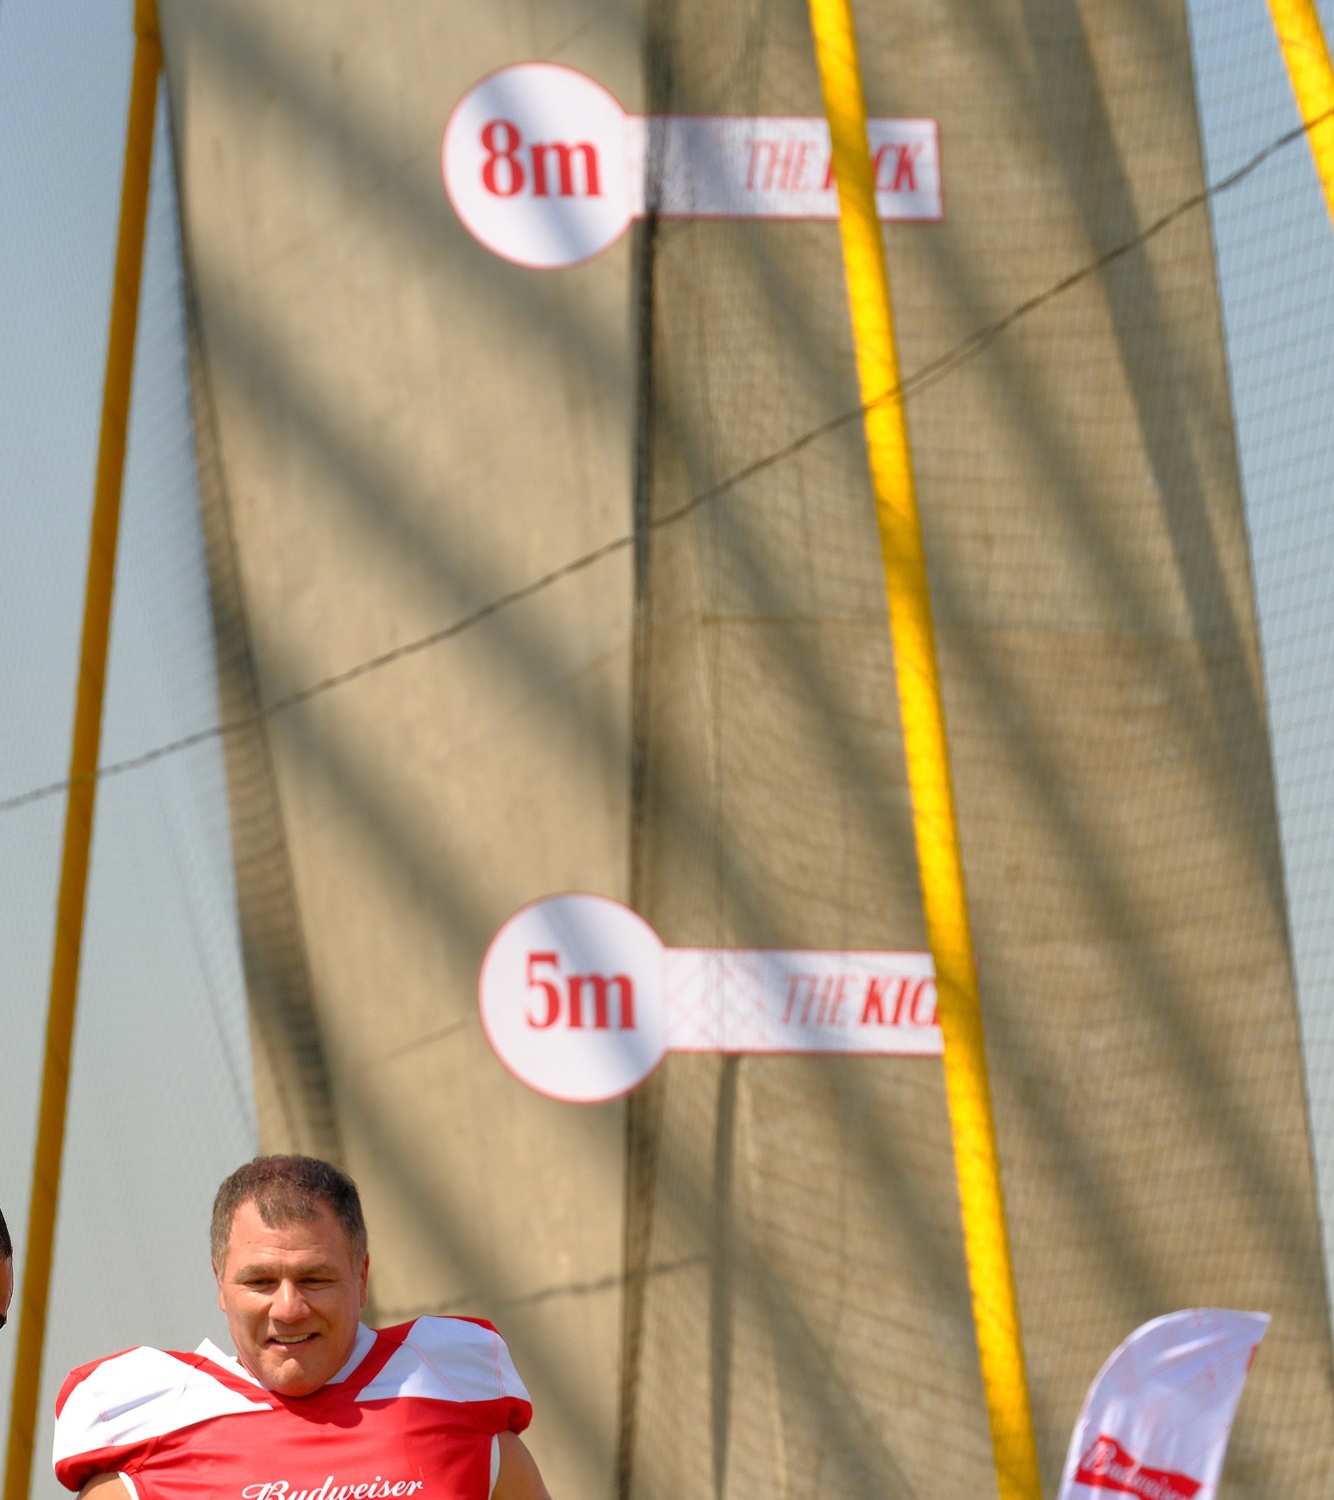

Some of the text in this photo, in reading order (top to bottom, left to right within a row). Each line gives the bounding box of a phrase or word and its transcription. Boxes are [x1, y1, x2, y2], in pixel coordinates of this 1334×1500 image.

[480, 118, 923, 199] 8m THE CK
[525, 950, 940, 1031] 5m THE KIC
